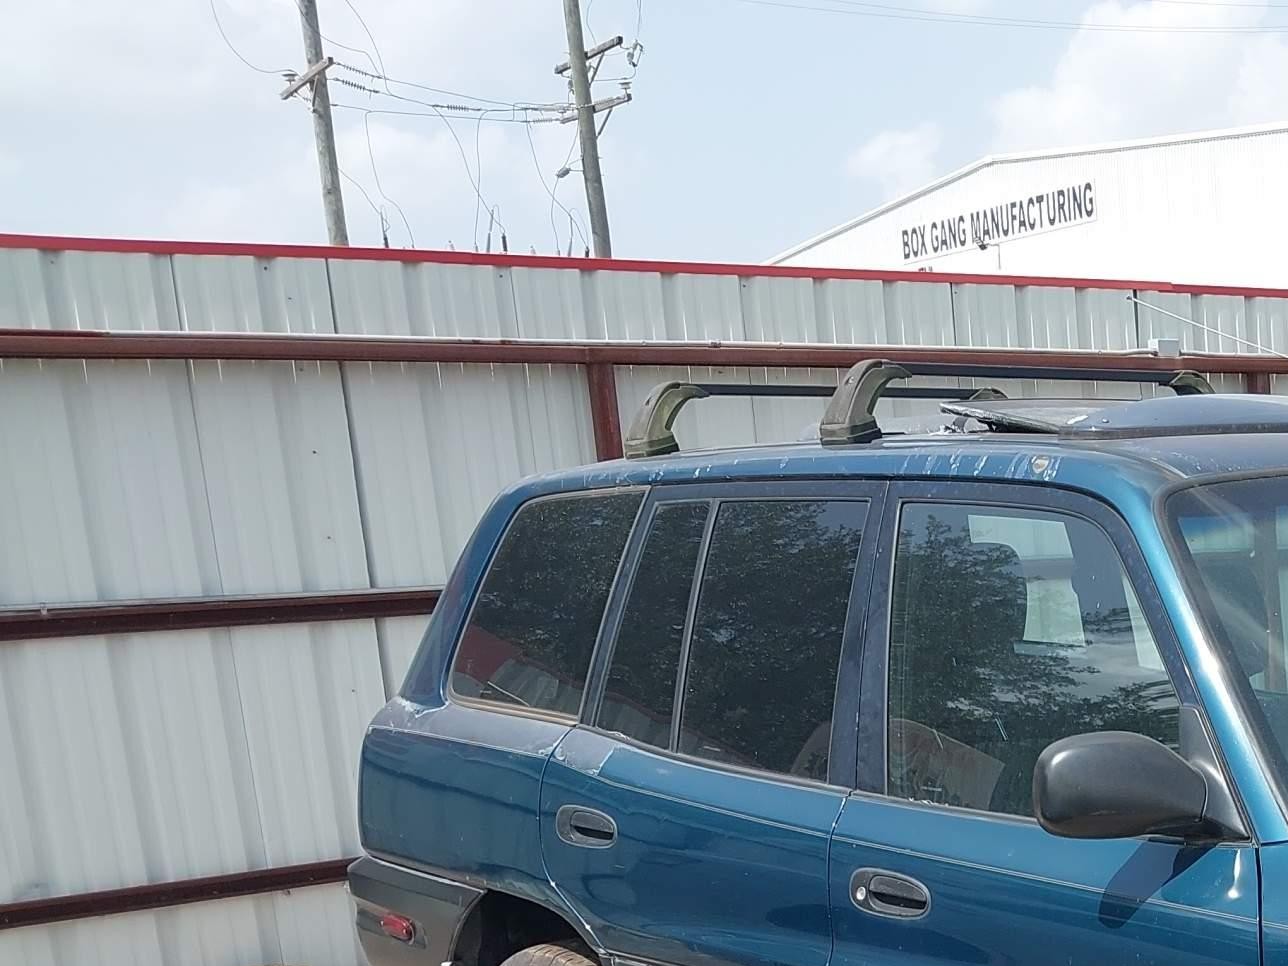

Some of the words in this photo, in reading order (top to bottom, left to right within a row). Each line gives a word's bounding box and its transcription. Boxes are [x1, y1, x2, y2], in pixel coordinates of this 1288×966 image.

[901, 223, 928, 260] BOX
[930, 215, 967, 253] GANG
[970, 182, 1095, 244] MANUFACTURING
